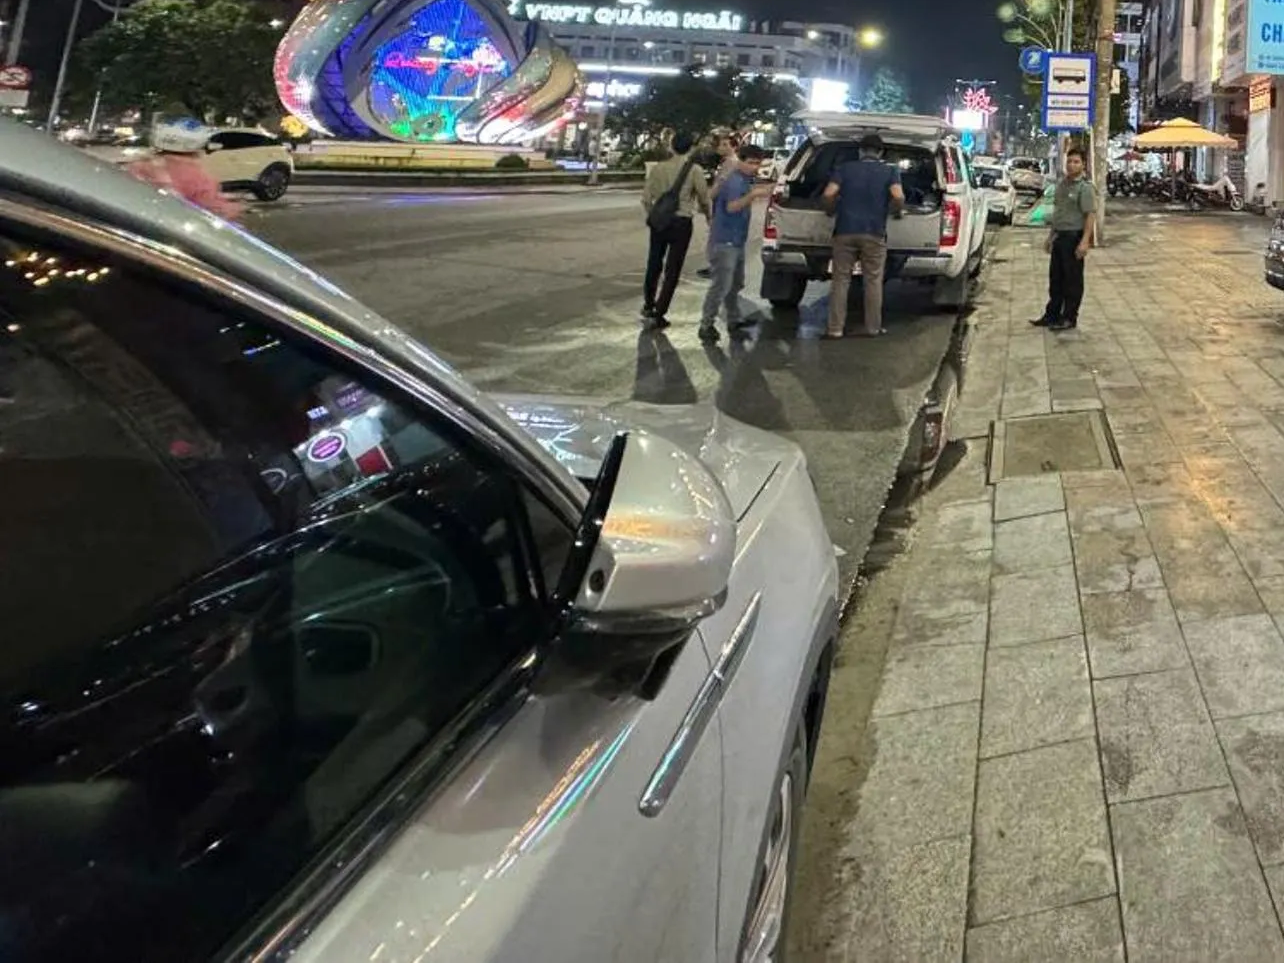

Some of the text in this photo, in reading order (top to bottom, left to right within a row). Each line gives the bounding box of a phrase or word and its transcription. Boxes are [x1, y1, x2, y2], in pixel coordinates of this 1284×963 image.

[525, 3, 742, 31] VNPT QUẢNG NGÃI
